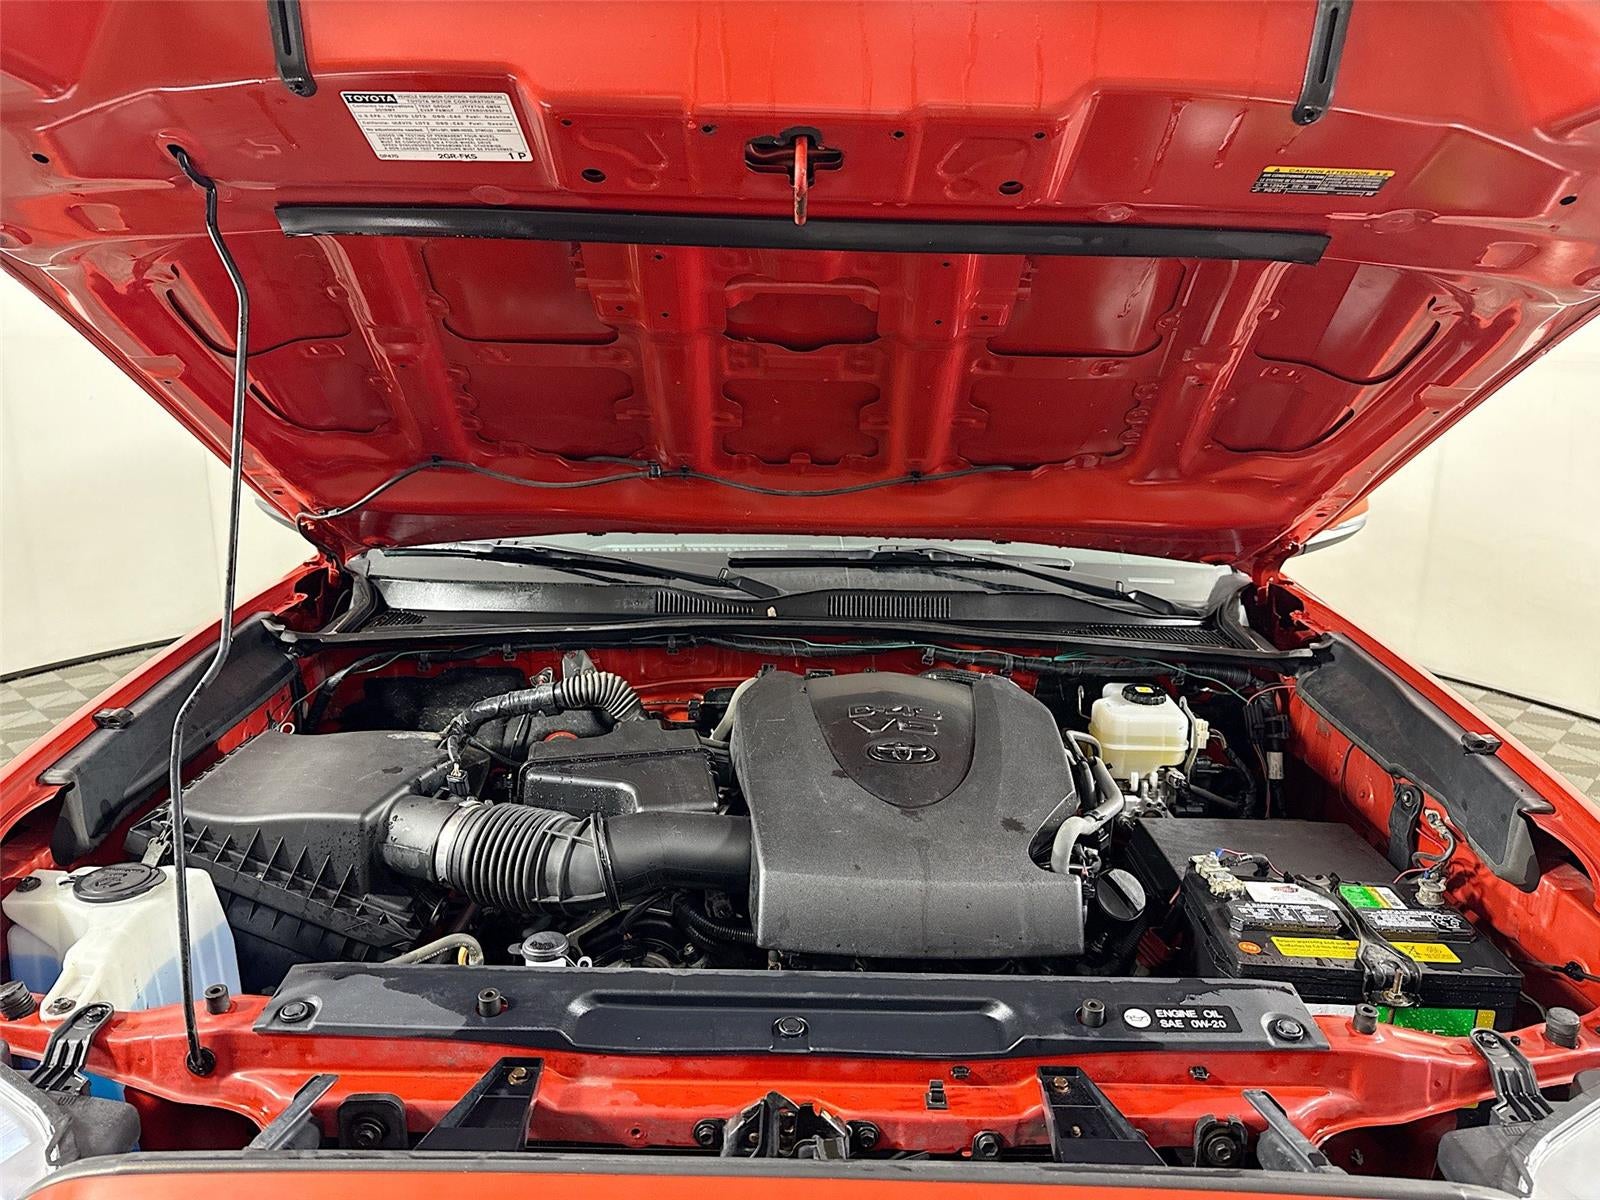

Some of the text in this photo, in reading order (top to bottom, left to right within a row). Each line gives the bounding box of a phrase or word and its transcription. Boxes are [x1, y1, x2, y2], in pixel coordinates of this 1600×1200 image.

[852, 717, 939, 736] V6
[1154, 1009, 1223, 1019] ENGINE OIL
[1159, 1019, 1227, 1029] SAE 0W-20
